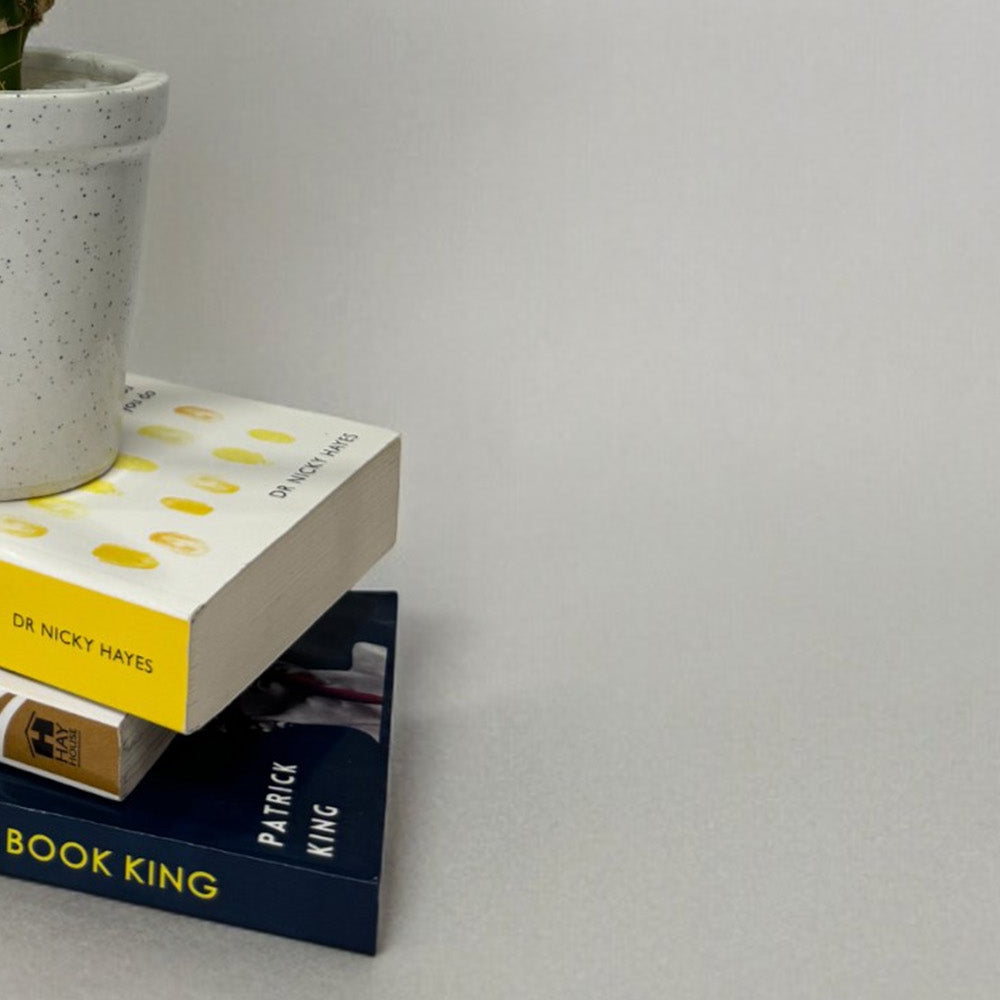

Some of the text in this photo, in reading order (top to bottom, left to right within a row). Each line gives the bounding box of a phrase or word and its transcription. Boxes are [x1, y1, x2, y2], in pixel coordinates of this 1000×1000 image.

[268, 432, 359, 499] DR NICKY HAYES
[12, 612, 35, 634] DR
[41, 623, 94, 652] NICKY
[100, 638, 154, 674] HAYES
[55, 722, 69, 764] HAY
[68, 728, 77, 767] HOUSE
[257, 761, 297, 848] PATRICK
[306, 803, 338, 858] KING
[6, 828, 112, 877] BOOK
[124, 855, 219, 899] KING
